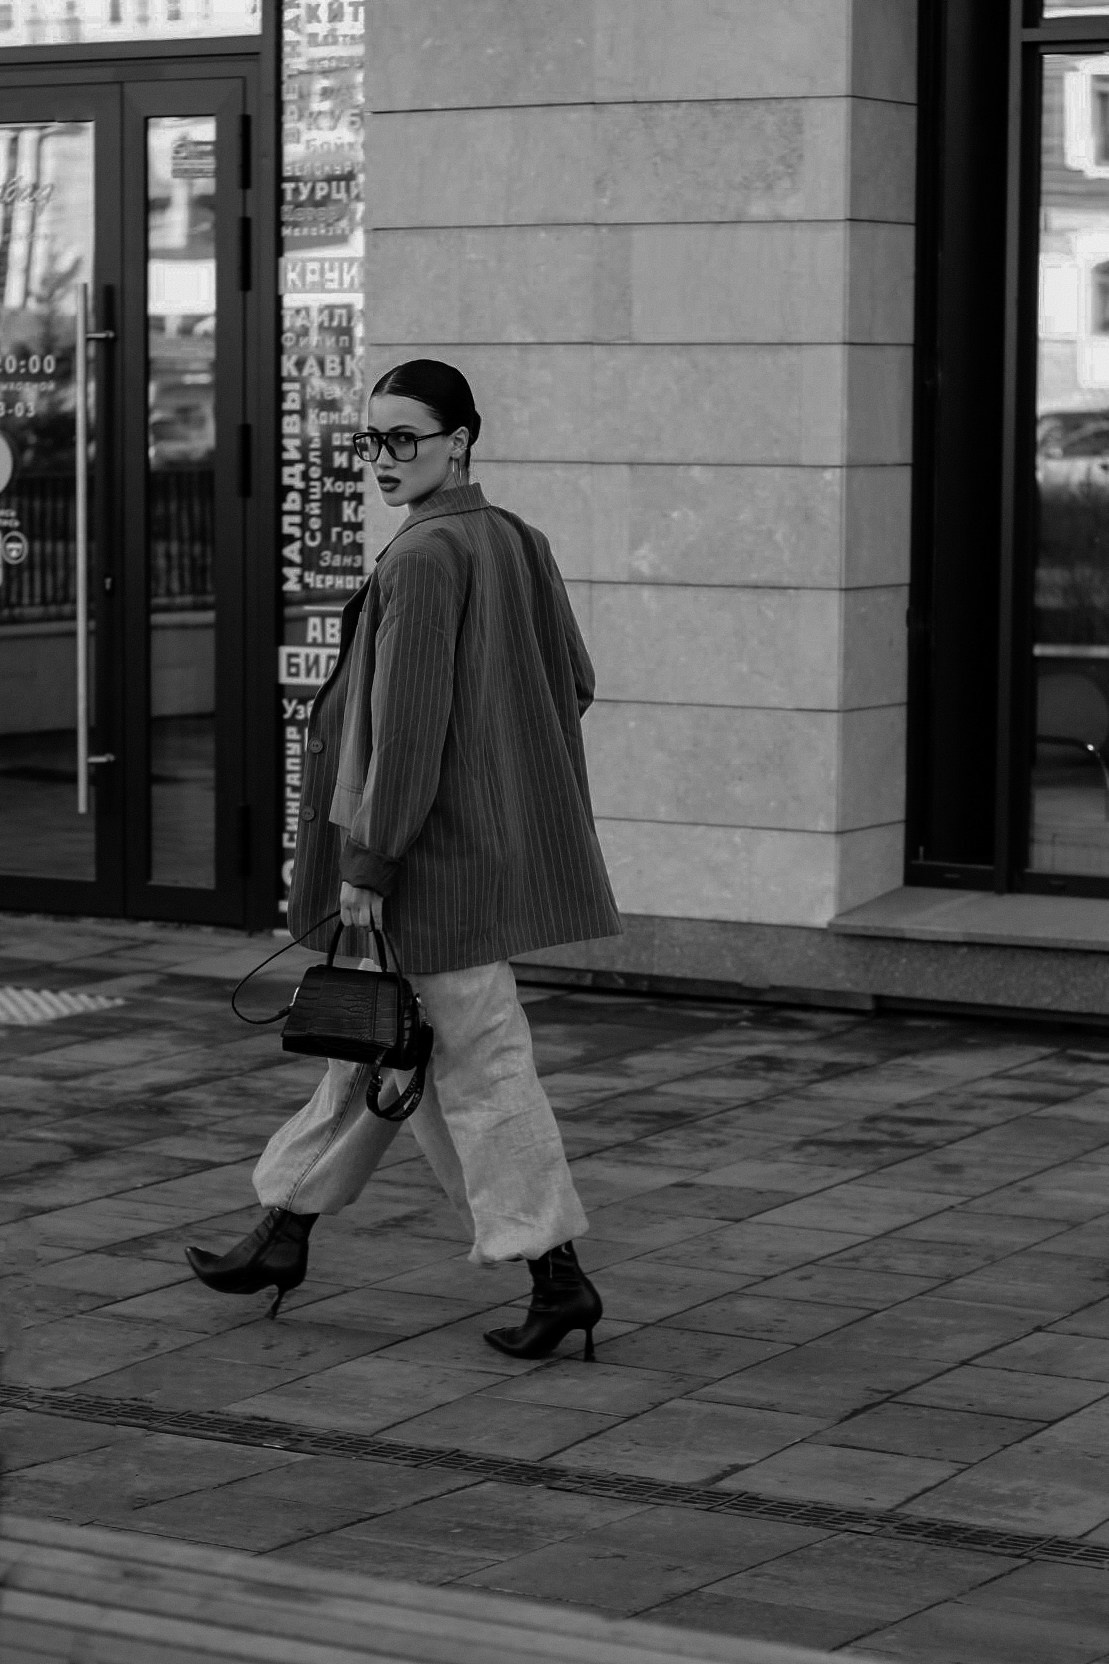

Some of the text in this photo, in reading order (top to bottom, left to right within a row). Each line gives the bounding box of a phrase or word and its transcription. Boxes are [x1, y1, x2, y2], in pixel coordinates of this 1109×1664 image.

[286, 261, 360, 289] КРУИ
[0, 354, 56, 374] 0:00
[281, 381, 305, 592] МАЛЬДИВЫ
[331, 526, 365, 546] Гре
[306, 616, 342, 644] АВ
